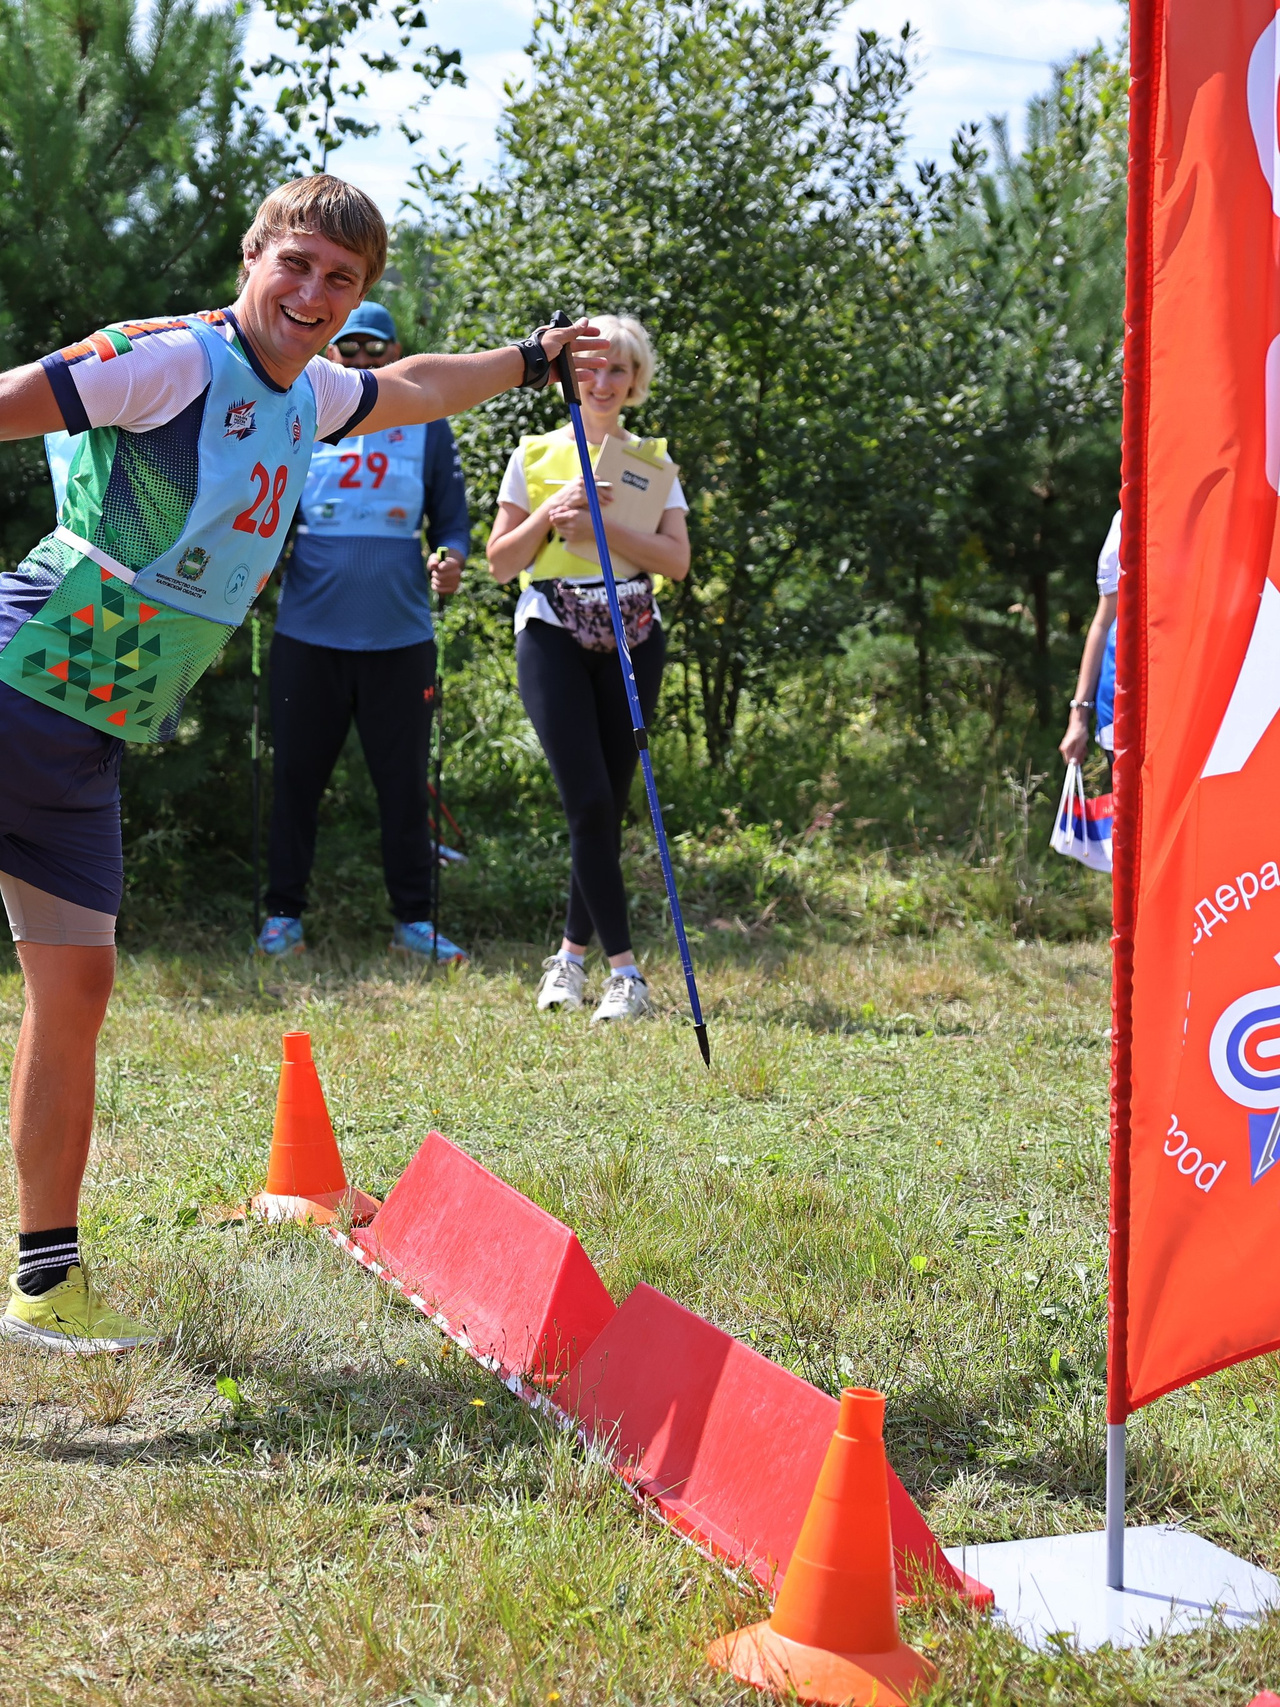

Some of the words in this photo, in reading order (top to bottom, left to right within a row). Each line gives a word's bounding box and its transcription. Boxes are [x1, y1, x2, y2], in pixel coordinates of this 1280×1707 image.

[338, 452, 388, 489] 29
[232, 461, 287, 539] 28
[577, 581, 647, 605] Supeme
